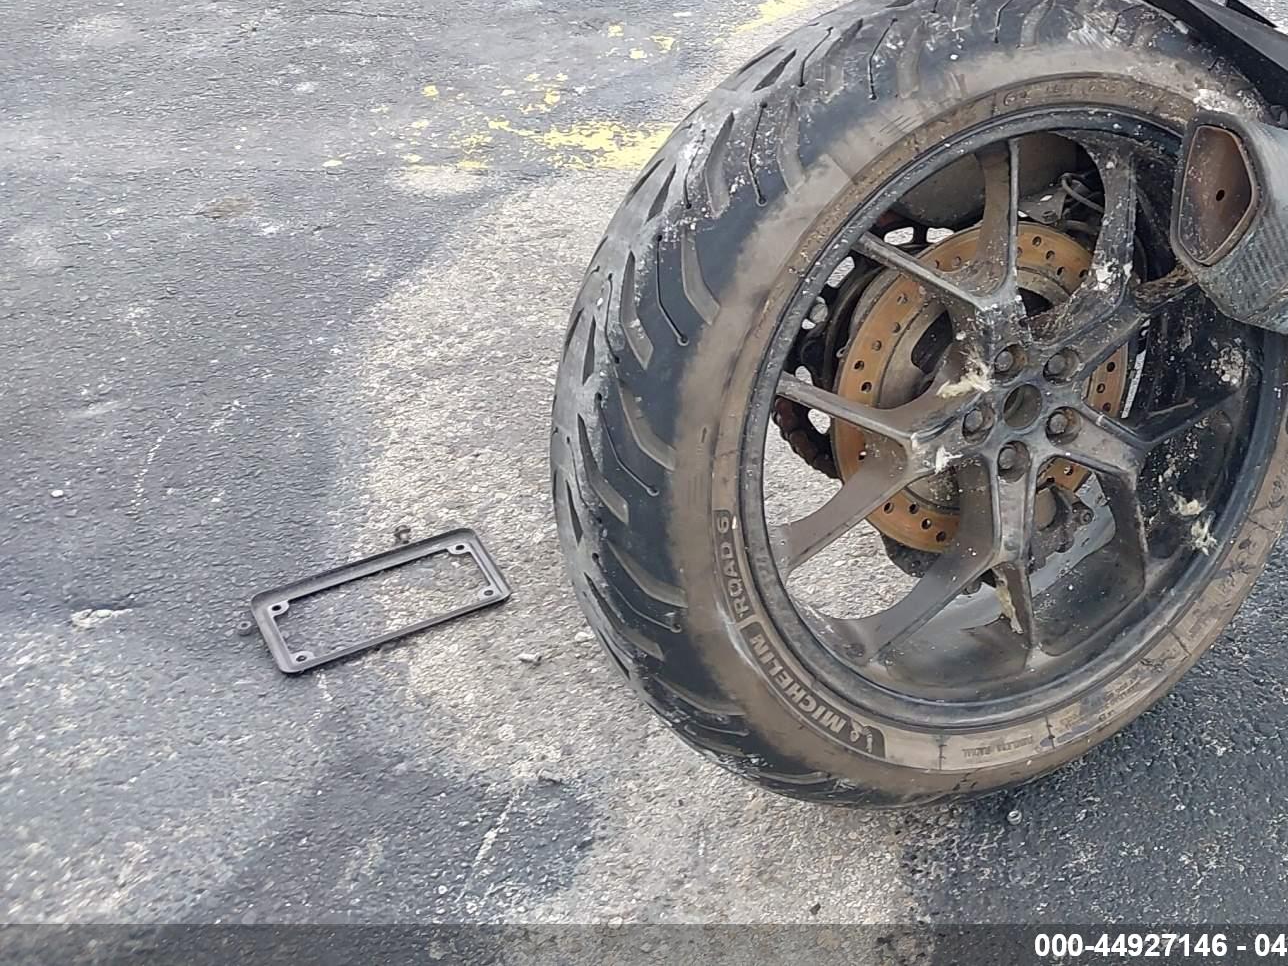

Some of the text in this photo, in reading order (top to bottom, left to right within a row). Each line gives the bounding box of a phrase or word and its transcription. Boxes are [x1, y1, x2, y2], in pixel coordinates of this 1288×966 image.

[716, 516, 750, 618] ROAD 6
[749, 633, 847, 734] MICHELIN
